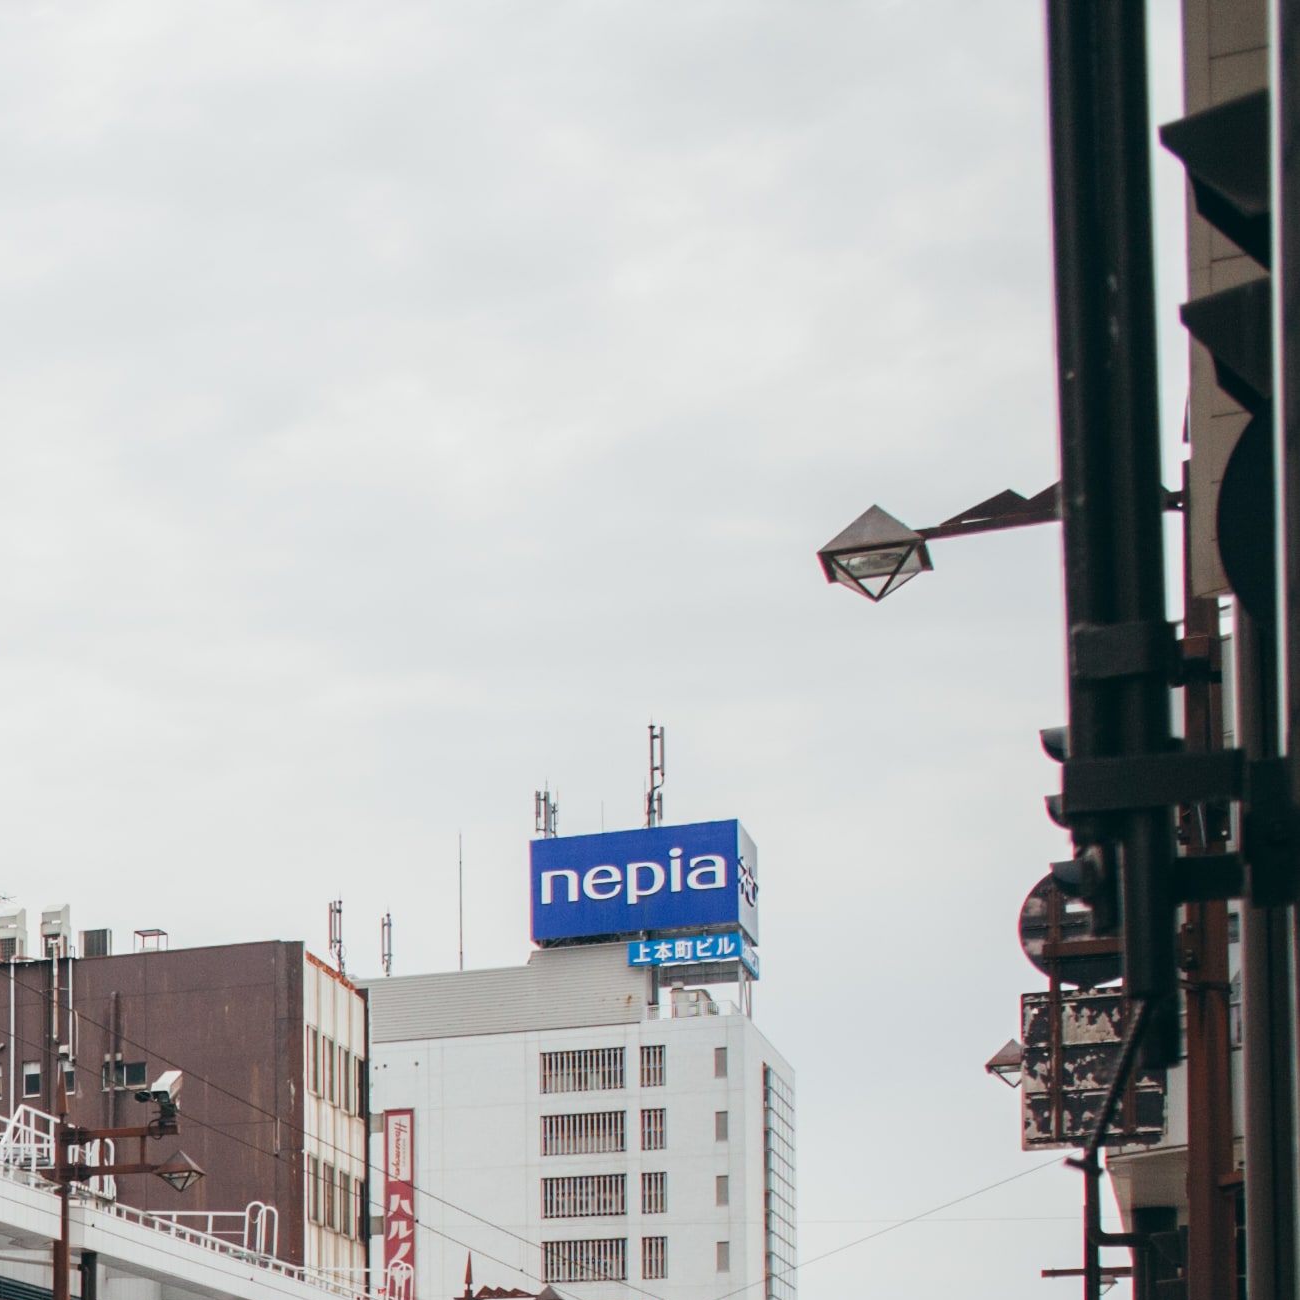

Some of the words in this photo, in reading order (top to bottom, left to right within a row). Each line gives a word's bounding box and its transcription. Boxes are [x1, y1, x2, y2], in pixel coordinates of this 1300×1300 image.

[540, 847, 727, 905] nepia
[632, 936, 736, 963] 上本町ビル
